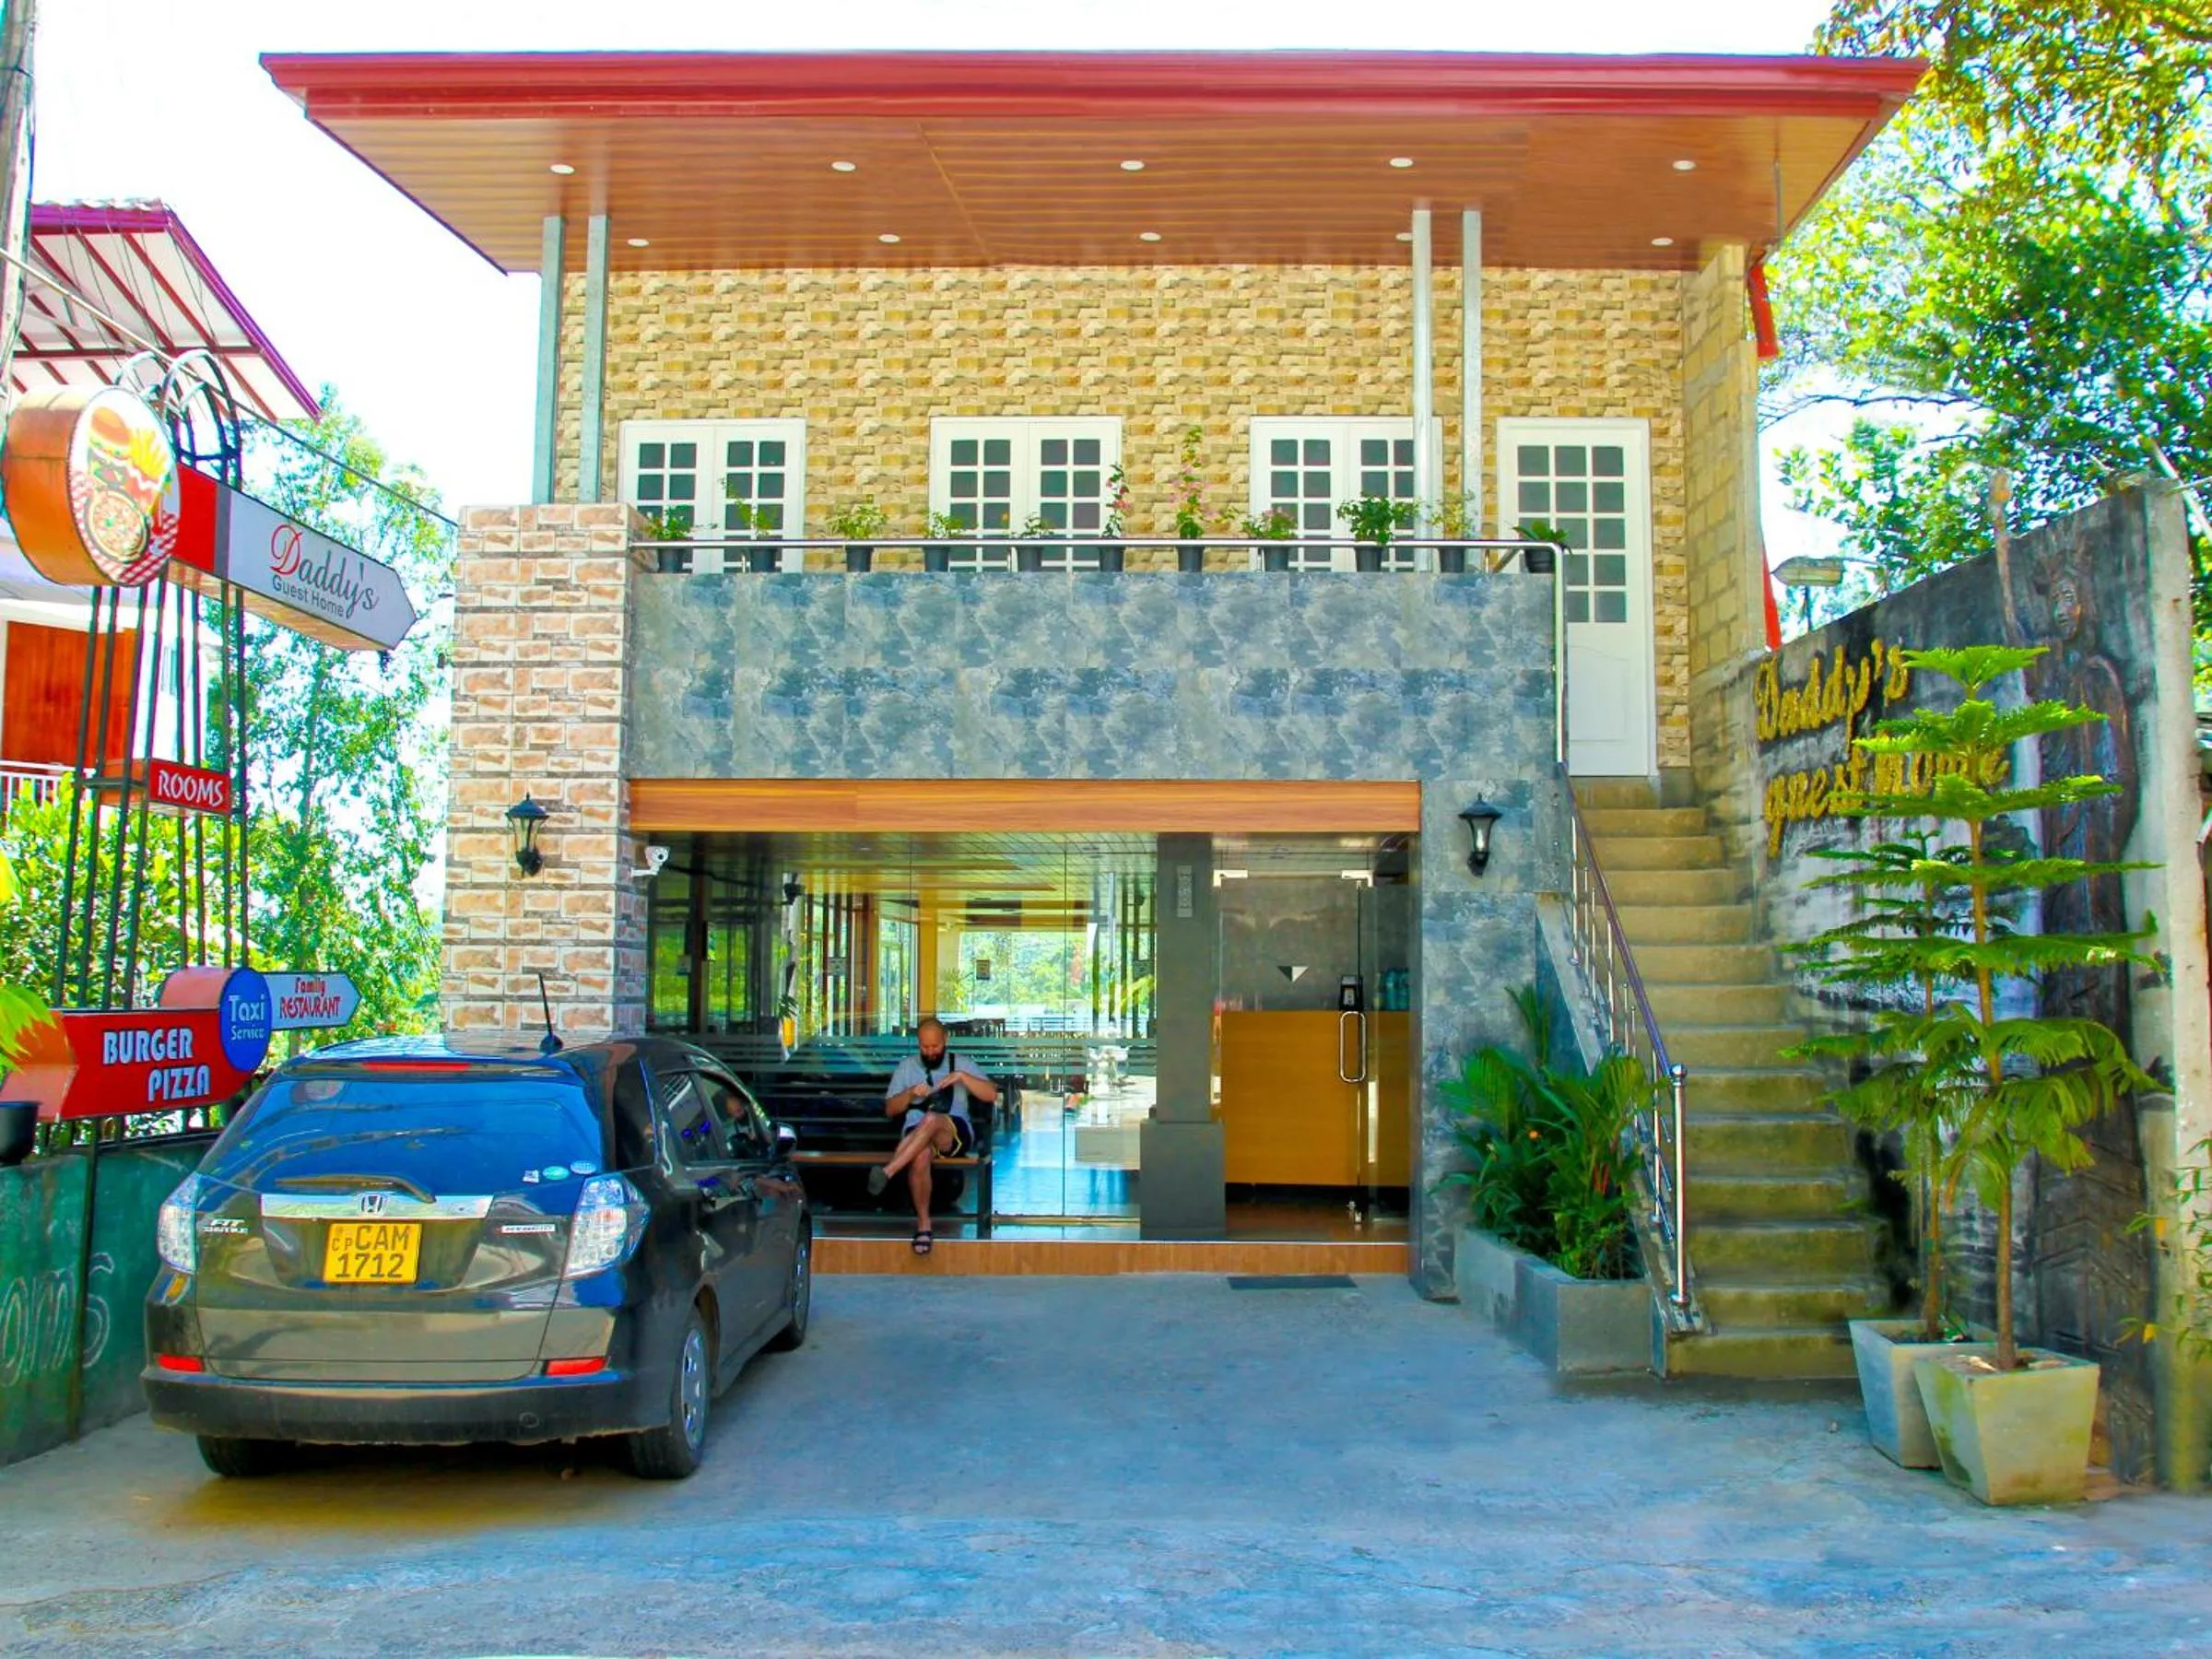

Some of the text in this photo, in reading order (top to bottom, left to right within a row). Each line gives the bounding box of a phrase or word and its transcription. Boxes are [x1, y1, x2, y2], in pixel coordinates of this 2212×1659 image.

[269, 524, 380, 620] Daddy's
[272, 574, 346, 618] Guest Home
[1754, 638, 1909, 753] Daddy's
[158, 769, 224, 807] ROOMS
[295, 977, 326, 996] Family
[229, 994, 265, 1022] Taxi
[279, 995, 342, 1019] RESTAURANT
[102, 1028, 194, 1065] BURGER
[230, 1025, 265, 1041] Service
[147, 1064, 211, 1102] PIZZA
[354, 1224, 411, 1252] CAM
[334, 1253, 406, 1278] 1712
